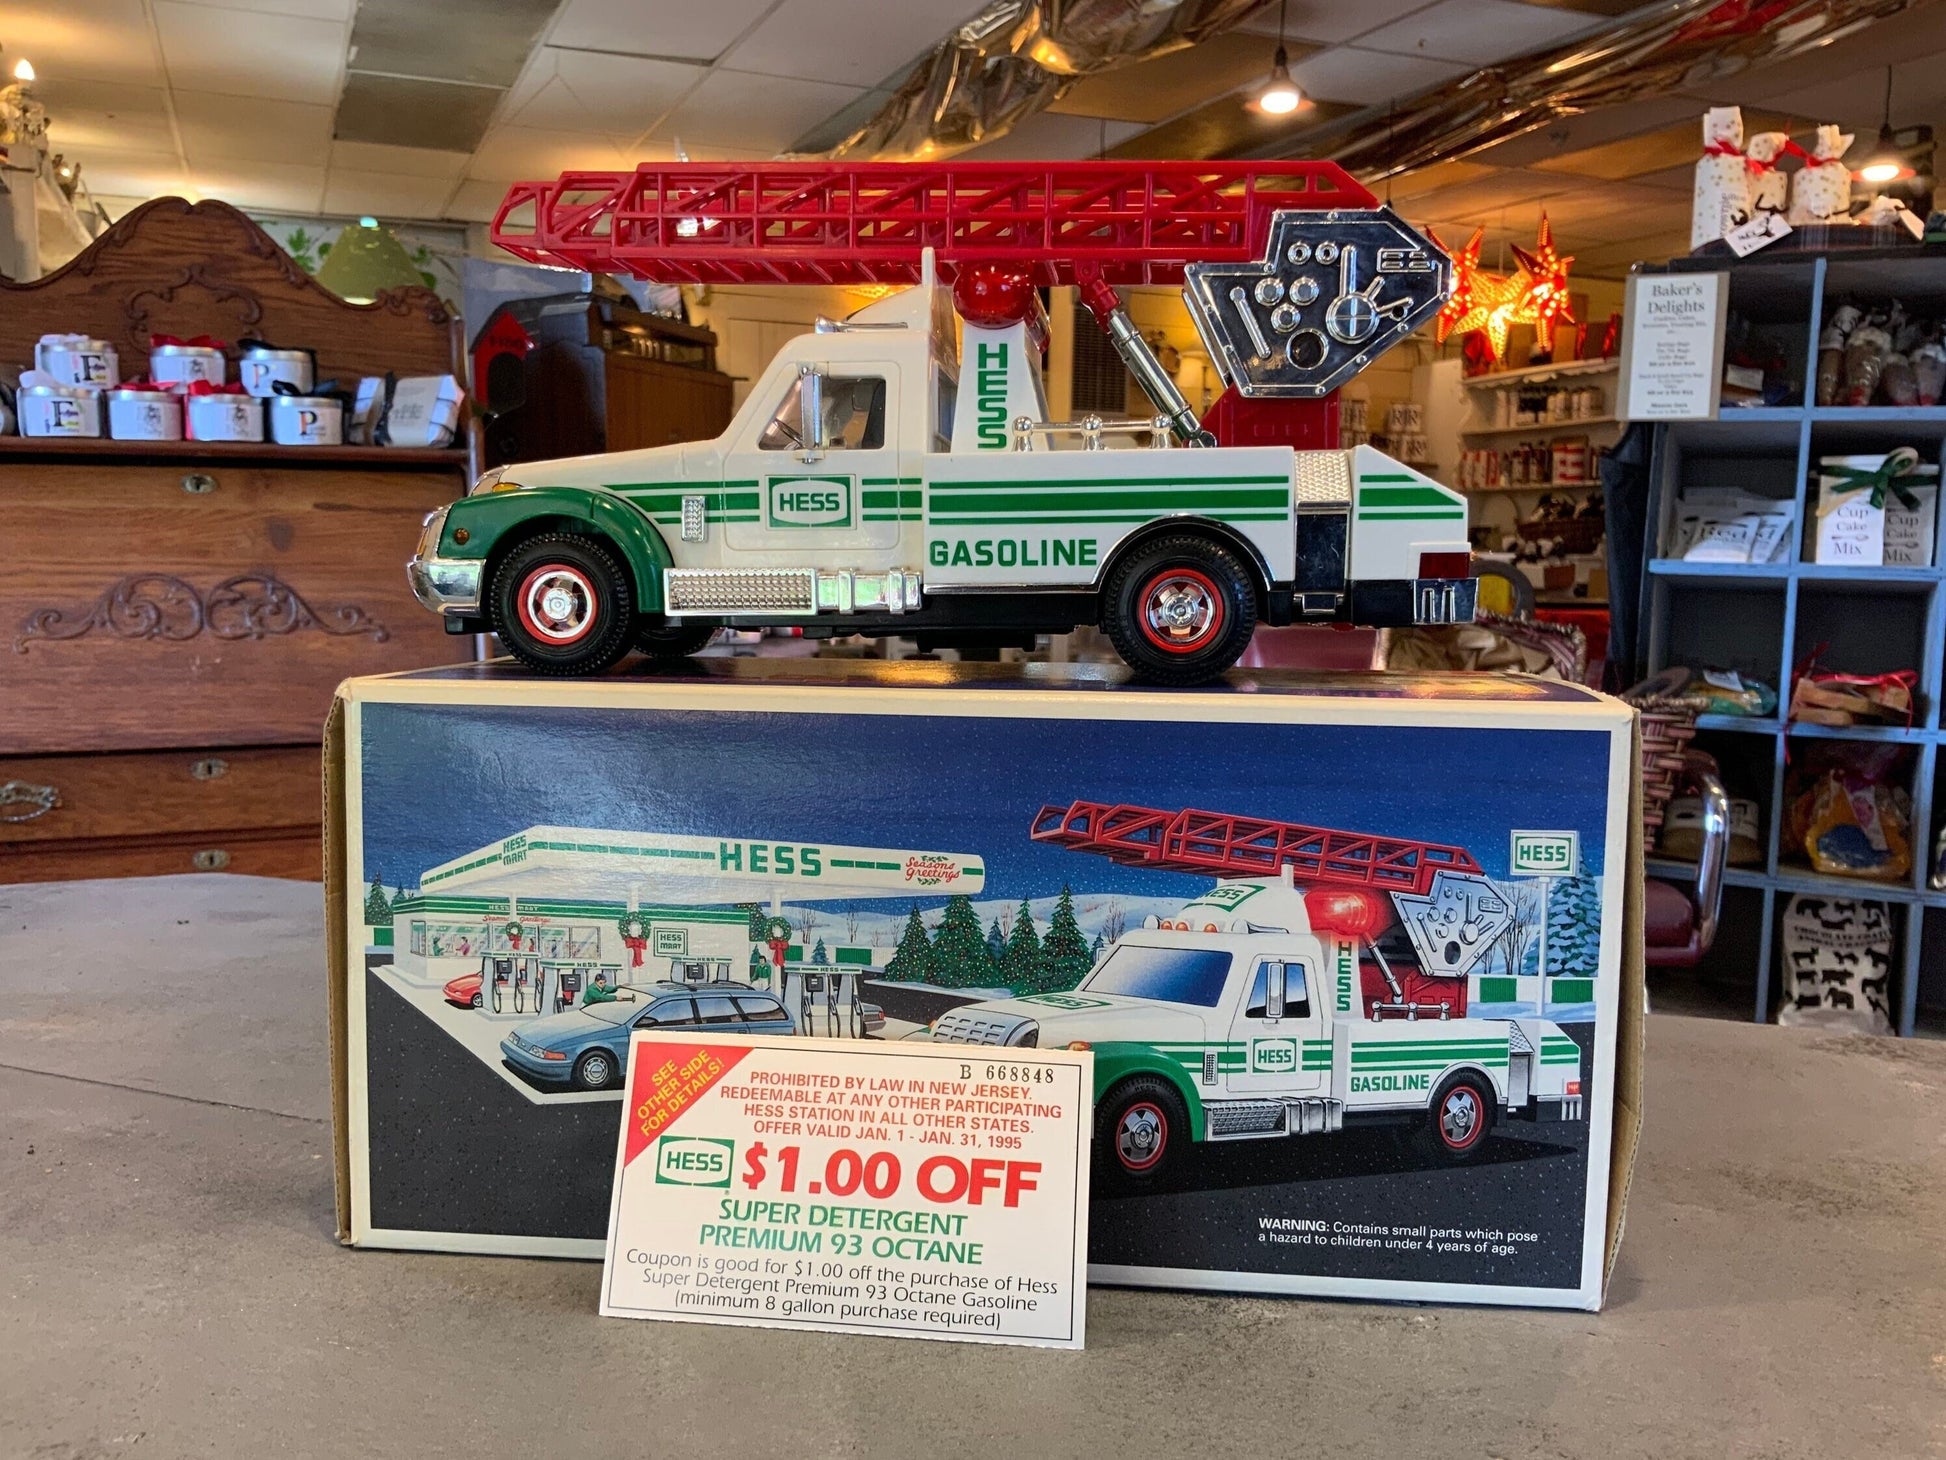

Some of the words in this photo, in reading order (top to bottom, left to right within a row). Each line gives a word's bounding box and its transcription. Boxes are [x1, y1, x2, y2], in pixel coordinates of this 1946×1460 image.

[1652, 282, 1703, 297] Baker's
[1648, 300, 1705, 314] Delights
[977, 343, 1008, 449] HESS
[299, 410, 317, 436] P
[779, 492, 839, 512] HESS
[1837, 507, 1869, 519] Cup
[1836, 521, 1868, 532] Cake
[1886, 528, 1918, 539] Cake
[1887, 515, 1920, 528] Cup
[930, 539, 1097, 567] GASOLINE
[1833, 543, 1863, 556] Mix
[1884, 549, 1913, 562] Mix
[503, 835, 527, 854] HESS
[1520, 845, 1566, 861] HESS
[503, 850, 527, 866] MART
[720, 842, 822, 877] HESS
[906, 857, 956, 869] Seasons
[660, 934, 682, 942] HESS
[1337, 941, 1352, 1011] HESS
[1257, 1049, 1292, 1063] HESS
[637, 1077, 682, 1121] OTHER
[679, 1049, 712, 1080] SIDE
[651, 1059, 678, 1087] SEE
[959, 1064, 972, 1080] B
[985, 1065, 1054, 1084] 668848
[1351, 1074, 1430, 1092] GASOLINE
[640, 1110, 670, 1137] FOR
[668, 1056, 726, 1113] DETAILS!
[750, 1071, 840, 1089] PROHIBITED
[844, 1076, 865, 1090] BY
[869, 1078, 904, 1093] LAW
[908, 1080, 925, 1094] IN
[929, 1082, 966, 1096] NEW
[970, 1084, 1033, 1101] JERSEY.
[720, 1086, 822, 1104] REDEEMABLE
[826, 1092, 846, 1106] AT
[849, 1094, 884, 1108] ANY
[888, 1096, 940, 1111] OTHER
[945, 1099, 1063, 1119] PARTICIPATING
[744, 1104, 784, 1118] HESS
[788, 1107, 855, 1123] STATION
[859, 1110, 876, 1124] IN
[879, 1112, 909, 1126] ALL
[913, 1114, 966, 1129] OTHER
[970, 1117, 1035, 1134] STATES.
[753, 1120, 801, 1135] OFFER
[806, 1124, 851, 1138] VALID
[855, 1128, 892, 1142] JAN.
[897, 1130, 904, 1142] 1
[918, 1131, 956, 1145] JAN.
[959, 1134, 983, 1149] 31,
[988, 1136, 1023, 1150] 1995
[666, 1151, 724, 1173] HESS
[742, 1141, 902, 1200] $1.00
[916, 1155, 1043, 1208] OFF
[718, 1198, 801, 1225] SUPER
[808, 1204, 969, 1236] DETERGENT
[1258, 1217, 1331, 1232] WARNING:
[1333, 1221, 1389, 1235] Contains
[1391, 1225, 1427, 1237] small
[1429, 1228, 1462, 1239] parts
[1465, 1228, 1504, 1240] which
[1507, 1232, 1539, 1243] pose
[699, 1224, 823, 1254] PREMIUM
[830, 1233, 863, 1257] 93
[872, 1236, 984, 1265] OCTANE
[1258, 1233, 1266, 1242] a
[1269, 1231, 1312, 1244] hazard
[1314, 1235, 1328, 1245] to
[1330, 1234, 1382, 1248] children
[1385, 1238, 1423, 1249] under
[1425, 1240, 1434, 1250] 4
[1436, 1242, 1472, 1253] years
[1474, 1242, 1488, 1252] of
[1491, 1245, 1519, 1256] age.
[626, 1248, 693, 1269] Coupon
[697, 1253, 709, 1269] is
[714, 1258, 760, 1274] good
[765, 1259, 788, 1275] for
[794, 1260, 844, 1279] $1.00
[849, 1265, 872, 1281] off
[877, 1267, 905, 1283] the
[910, 1271, 989, 1288] purchase
[994, 1276, 1013, 1291] of
[1017, 1277, 1059, 1295] Hess
[643, 1268, 691, 1288] Super
[696, 1272, 780, 1295] Detergent
[785, 1279, 860, 1300] Premium
[865, 1284, 887, 1300] 93
[893, 1286, 957, 1307] Octane
[962, 1292, 1039, 1312] Gasoline
[675, 1289, 760, 1310] (minimum
[765, 1295, 776, 1311] 8
[781, 1298, 835, 1316] gallon
[840, 1303, 918, 1322] purchase
[923, 1309, 1002, 1331] required)
